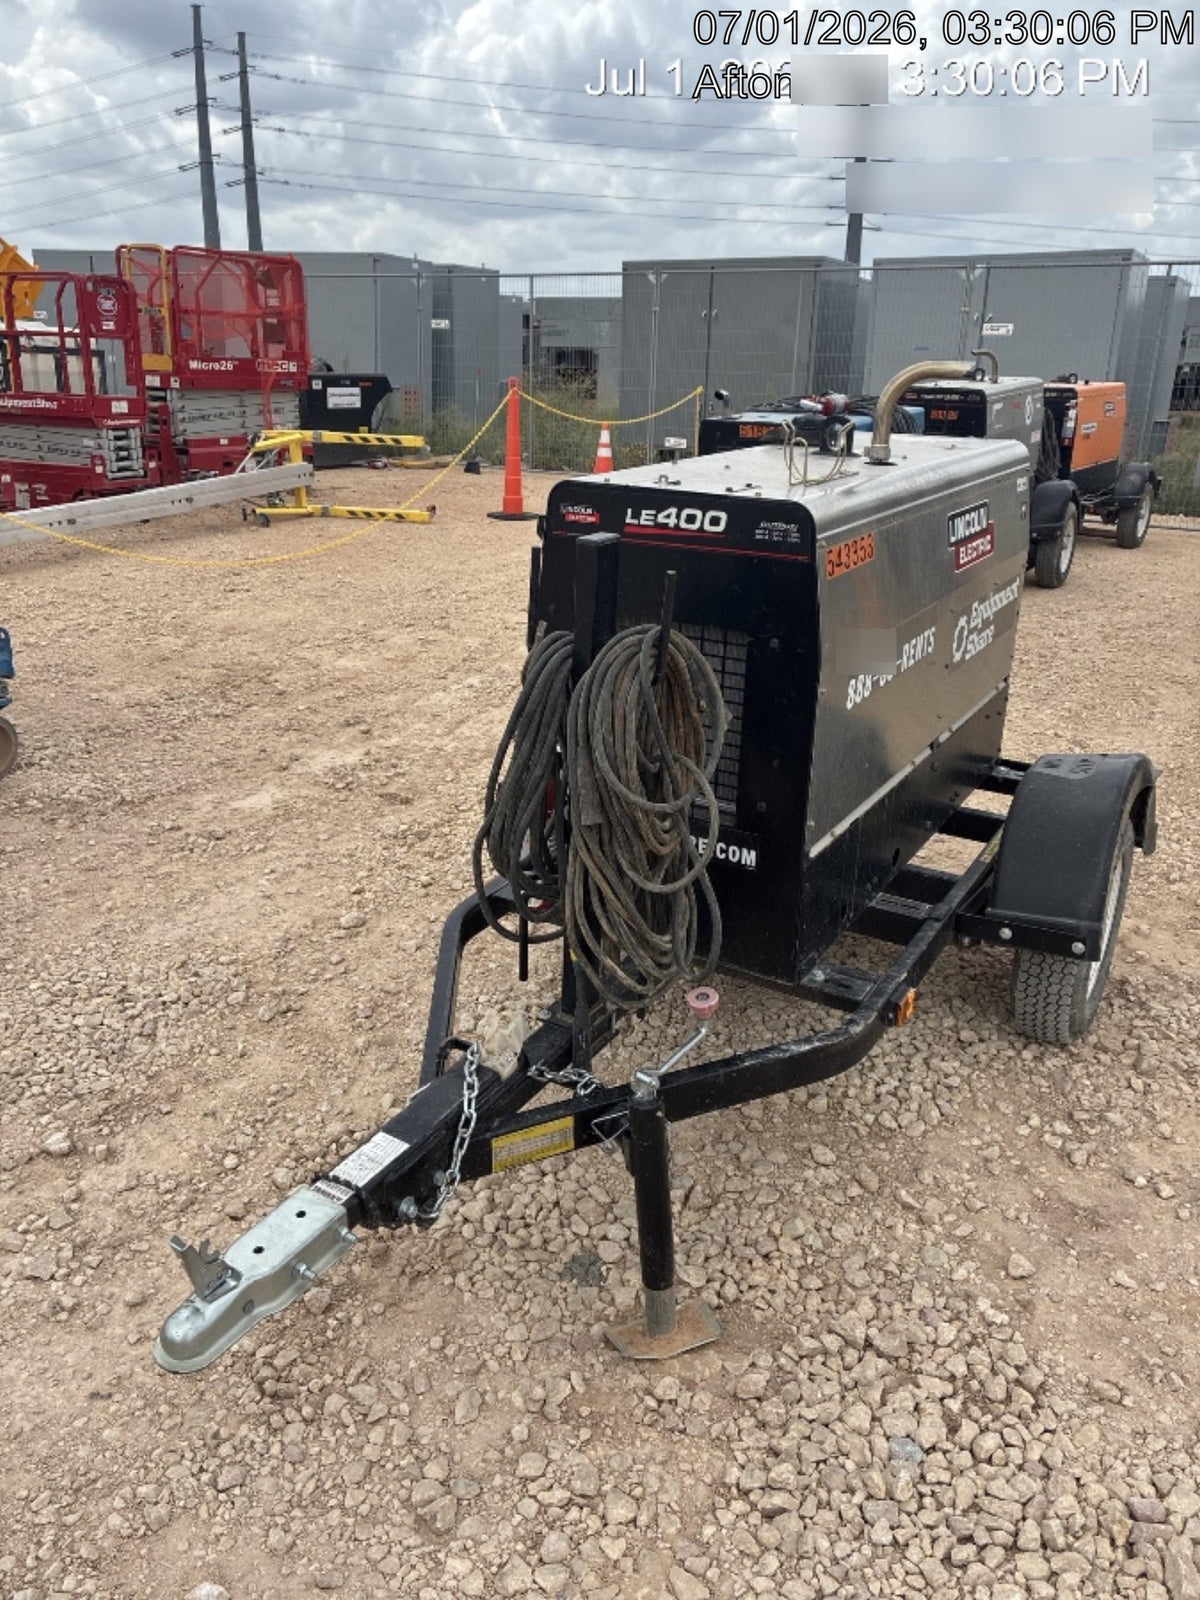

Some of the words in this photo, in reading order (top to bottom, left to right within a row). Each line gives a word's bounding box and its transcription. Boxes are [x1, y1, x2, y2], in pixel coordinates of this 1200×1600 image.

[625, 506, 728, 532] LE400
[949, 506, 988, 543] LINCOLN
[959, 533, 992, 565] ELECTRIC
[970, 576, 1021, 631] Equipment
[965, 624, 996, 662] Share
